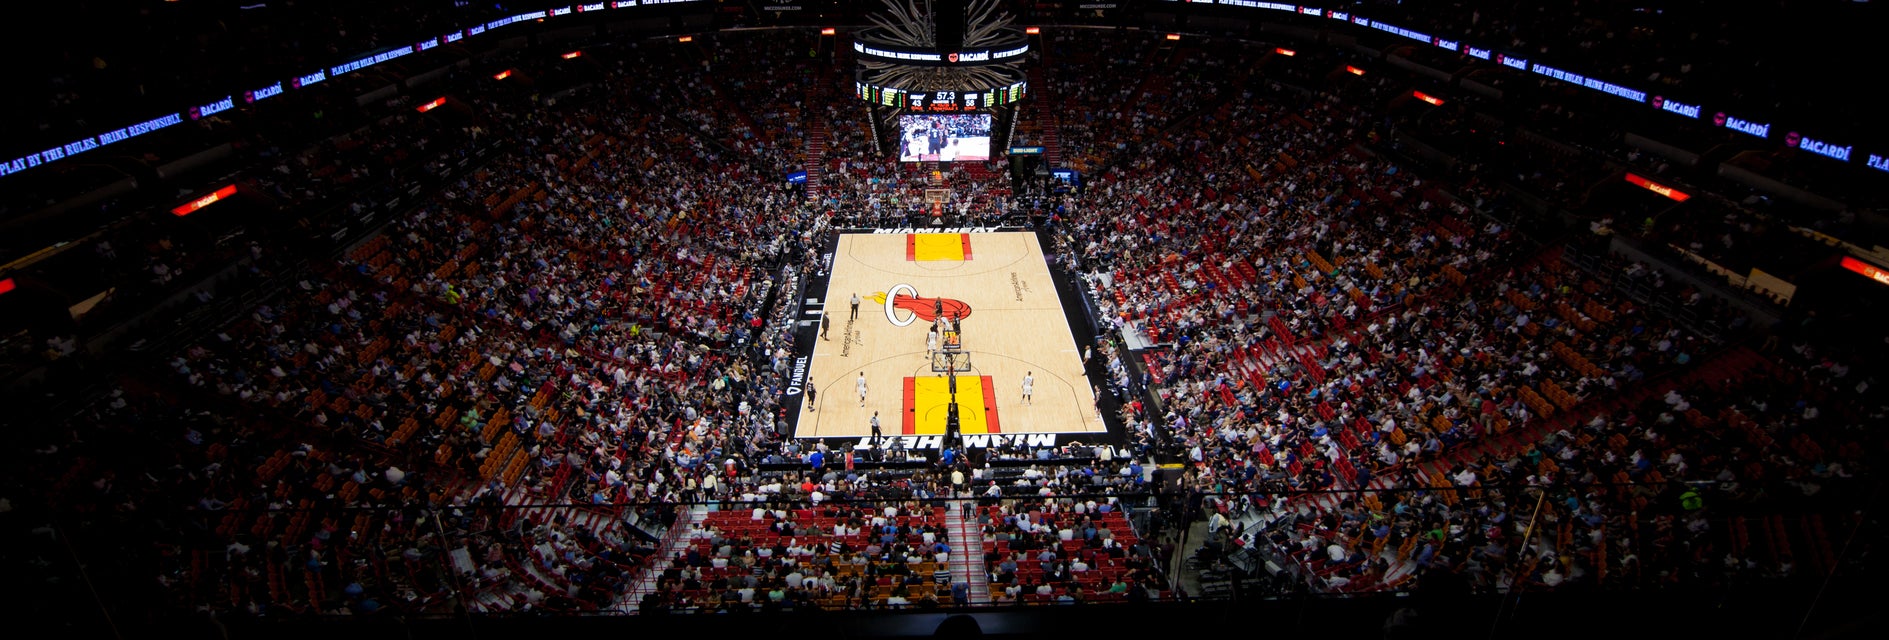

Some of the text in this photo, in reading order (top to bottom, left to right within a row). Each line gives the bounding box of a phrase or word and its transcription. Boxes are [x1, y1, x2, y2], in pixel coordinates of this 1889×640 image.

[959, 50, 989, 62] BACARDÍ
[1469, 48, 1490, 60] BACARDÍ
[1503, 57, 1527, 70] BACARDÍ
[1532, 64, 1545, 74] PLAY
[1545, 66, 1553, 76] BY
[1553, 68, 1564, 80] THE
[300, 69, 326, 86] BACARDÍ
[254, 81, 283, 100] BACARDÍ
[936, 91, 956, 101] 57.3
[200, 96, 234, 116] BACARDÍ
[912, 99, 923, 107] 43
[1663, 100, 1700, 118] BACARDÍ
[1726, 117, 1770, 138] BACARDÍ
[0, 112, 183, 175] PLAY BY THE RULES. DRINK RESPONSIBLY.
[1800, 137, 1852, 161] BACARDÍ
[872, 226, 1001, 235] MIAMI HEAT
[790, 355, 808, 386] FANDUEL
